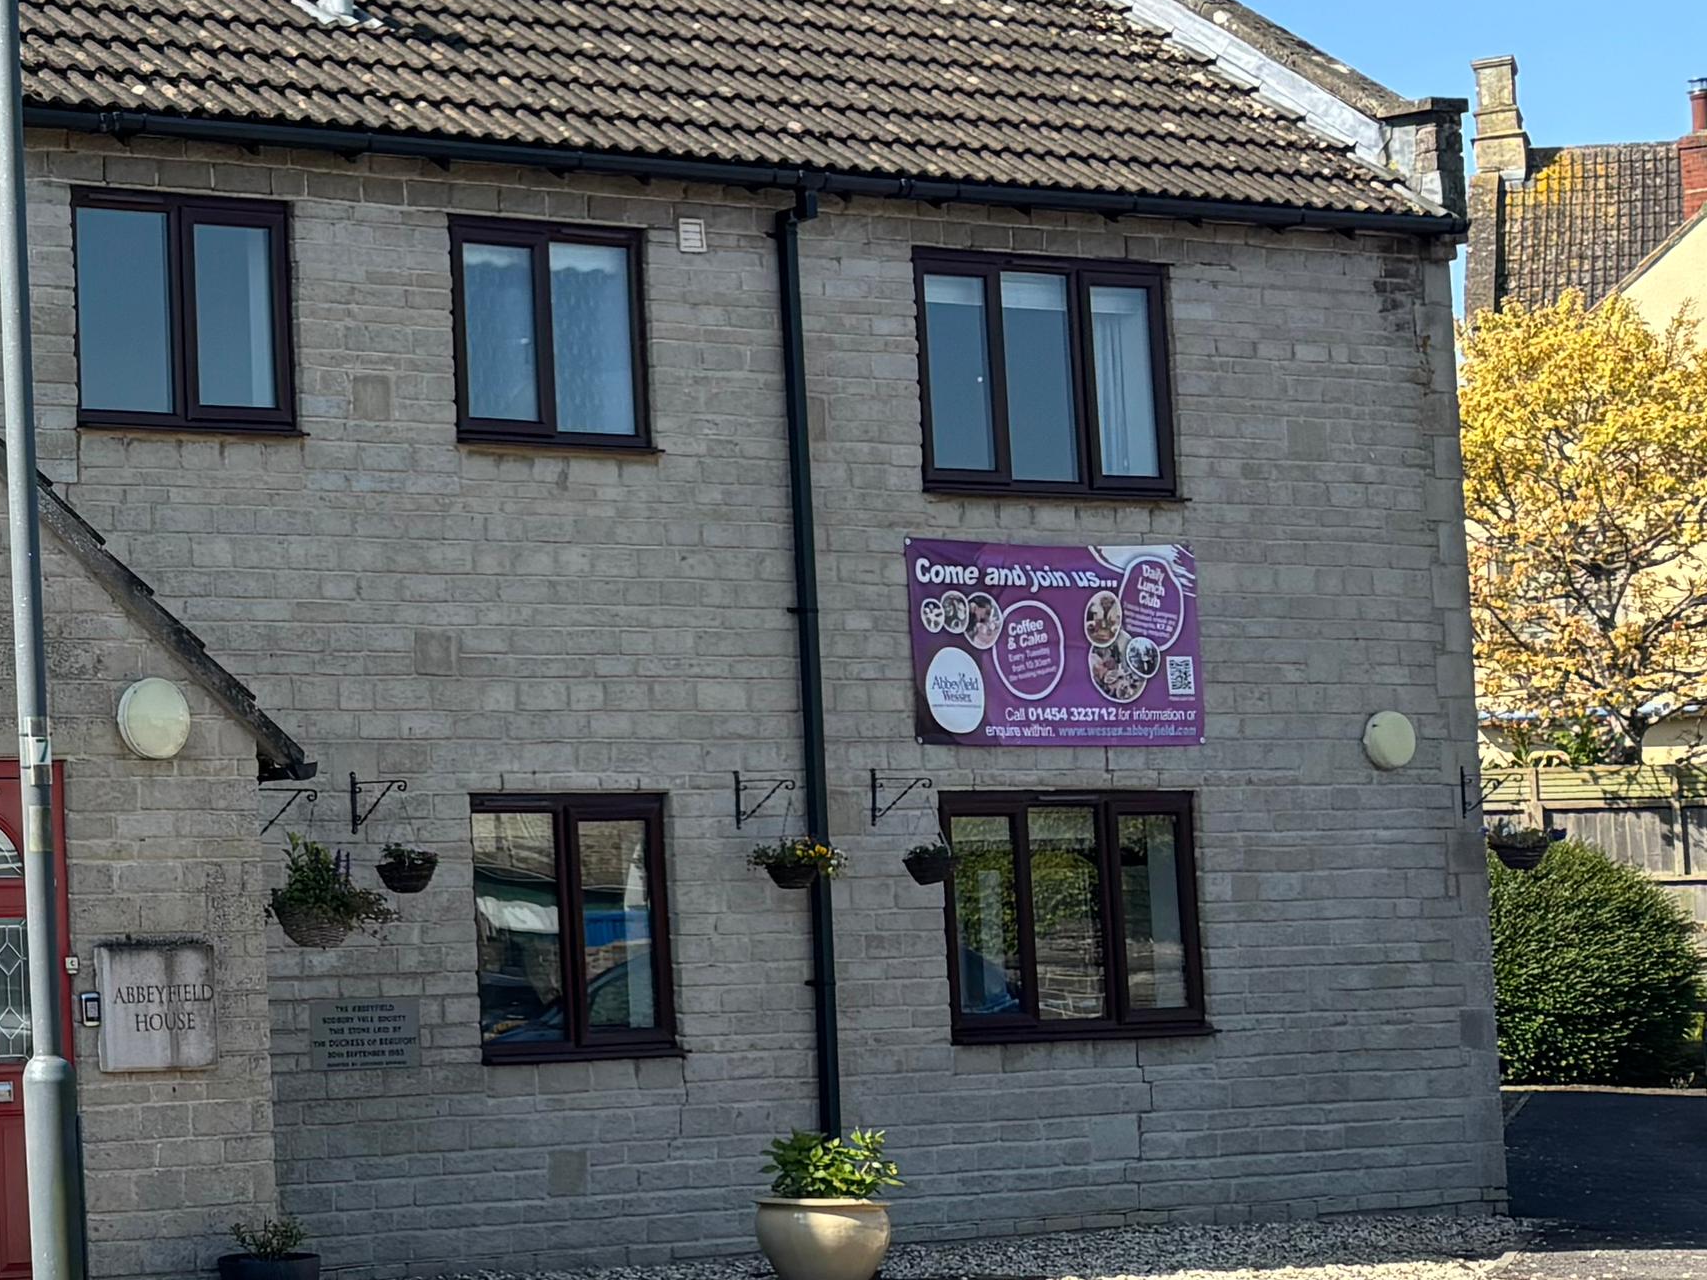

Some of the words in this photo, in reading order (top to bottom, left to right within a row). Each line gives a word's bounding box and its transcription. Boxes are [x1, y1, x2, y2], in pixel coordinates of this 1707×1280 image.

[915, 557, 980, 585] Come
[984, 565, 1027, 586] and
[1025, 566, 1071, 593] join
[1071, 570, 1118, 588] us...
[1142, 564, 1165, 584] Daily
[1137, 577, 1165, 597] Lunch
[1139, 592, 1161, 609] Club
[1008, 619, 1044, 636] Coffee
[1008, 637, 1016, 650] &
[1019, 632, 1048, 648] Cake
[1008, 653, 1025, 663] Every
[1011, 663, 1025, 673] from
[931, 672, 979, 693] Abbeyfield
[942, 690, 973, 702] Wessex
[1005, 707, 1026, 721] Call
[1028, 706, 1068, 721] 01454
[1070, 706, 1117, 721] 323712
[1118, 708, 1130, 721] for
[1132, 707, 1185, 721] information
[1187, 709, 1197, 721] or
[986, 725, 1022, 738] enquire
[1022, 724, 1055, 737] within.
[1058, 724, 1197, 739] www.wessex.abbeyfield.com
[36, 738, 48, 762] 7
[114, 984, 214, 1004] ABBEYFIELD
[135, 1012, 197, 1032] HOUSE
[329, 1038, 365, 1048] DUCHESS
